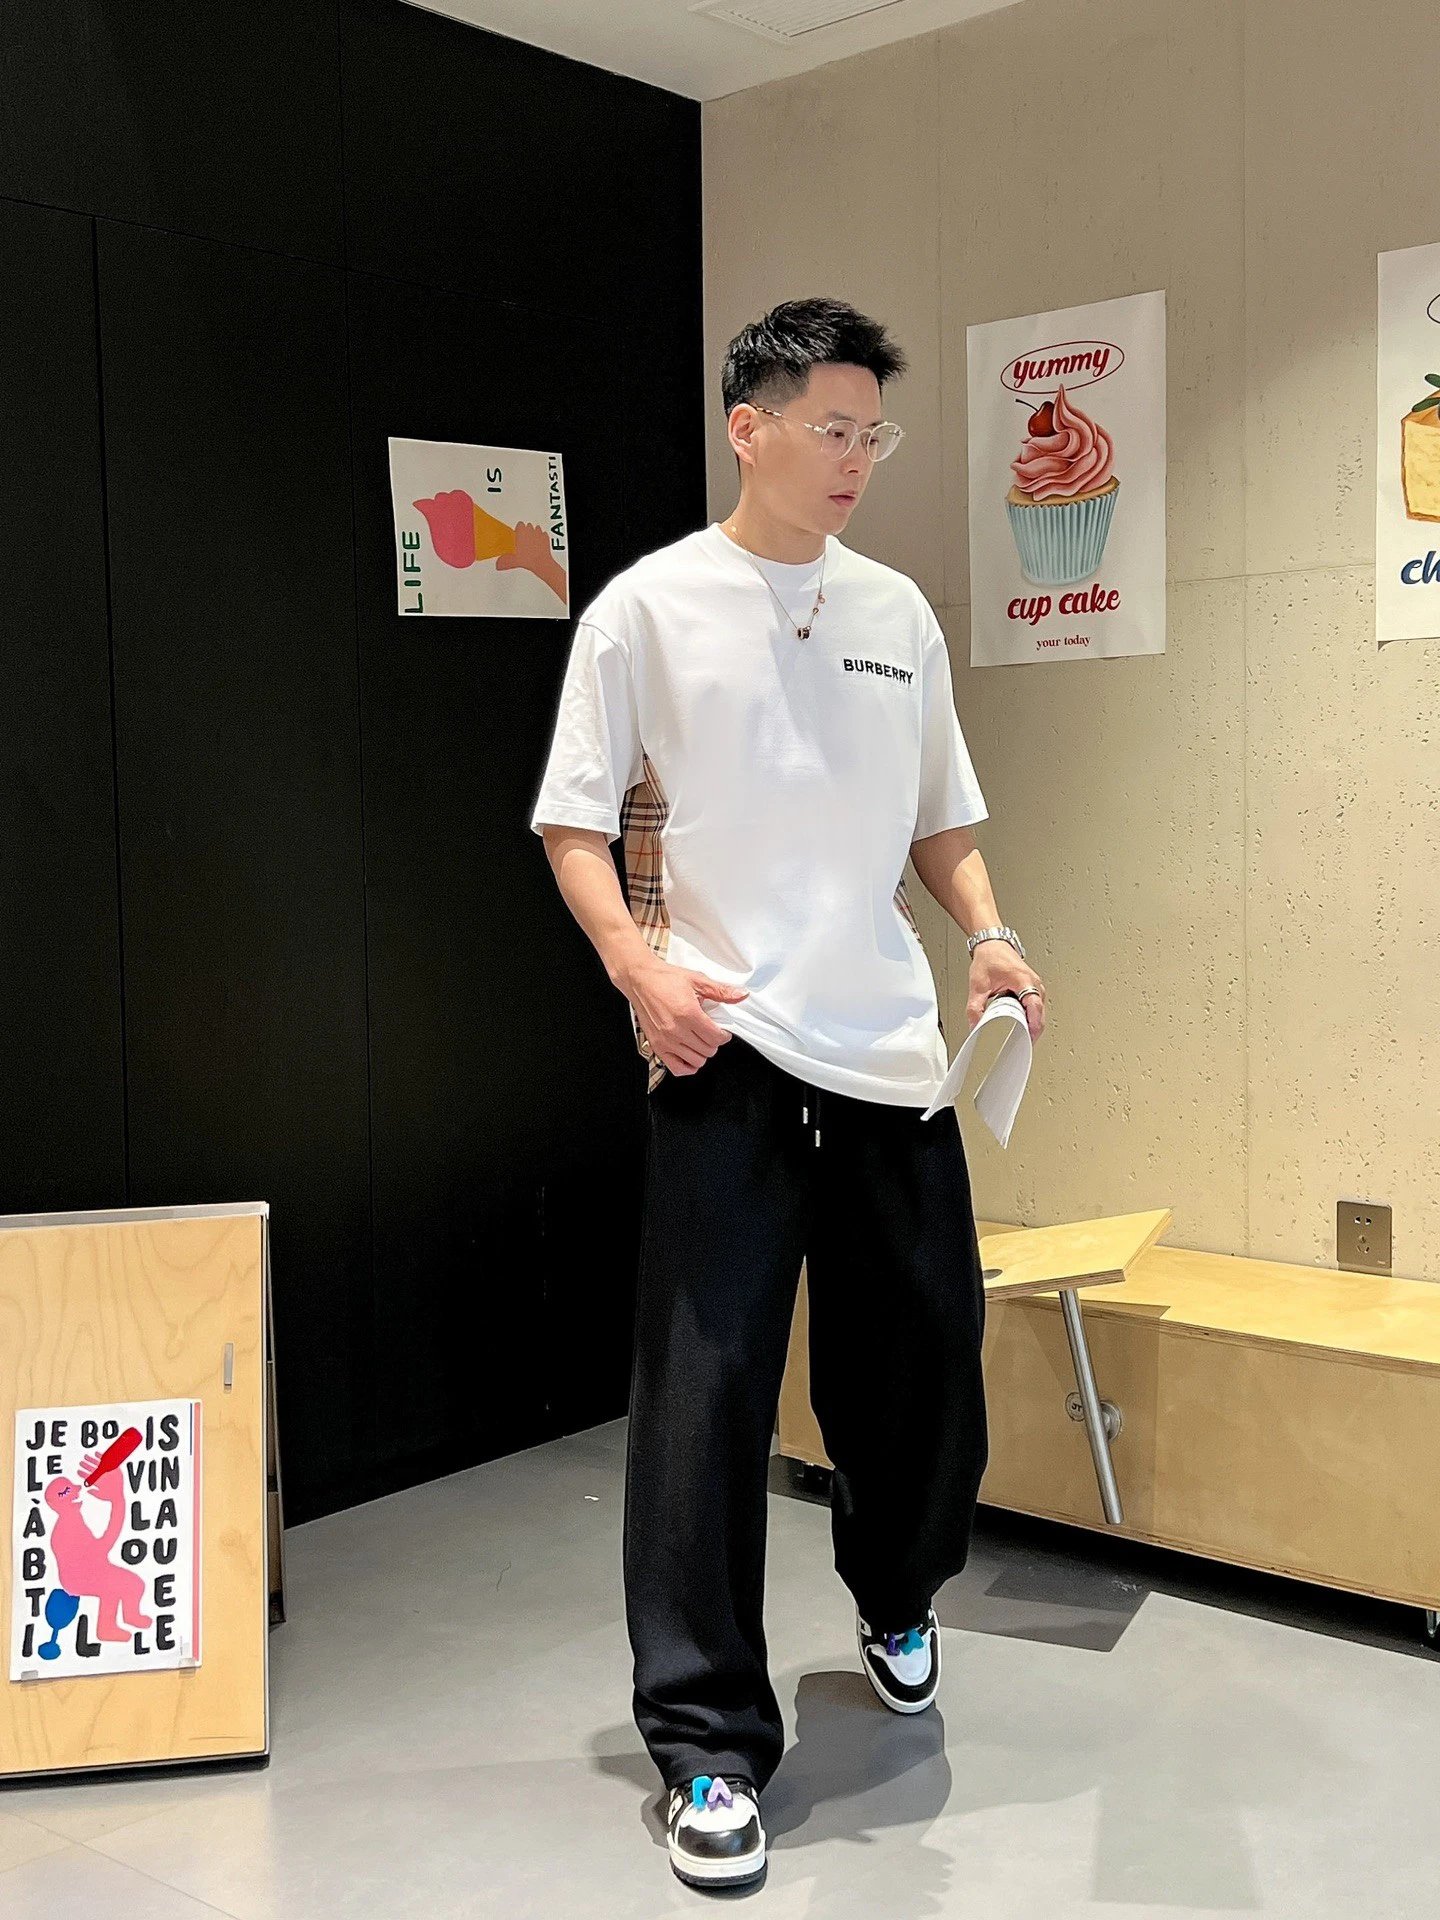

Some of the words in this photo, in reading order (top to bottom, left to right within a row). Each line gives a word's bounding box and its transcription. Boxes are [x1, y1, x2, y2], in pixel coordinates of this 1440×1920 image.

[1012, 347, 1110, 389] yummy
[486, 467, 502, 493] IS
[548, 456, 566, 551] FANTASTI
[402, 530, 424, 614] LIFE
[1007, 595, 1052, 626] cup
[1058, 583, 1121, 615] cake
[1036, 637, 1062, 651] your
[1064, 634, 1091, 647] today
[843, 658, 914, 685] BURBERRY
[25, 1420, 68, 1451] JE
[27, 1454, 63, 1493] LE
[126, 1455, 180, 1494] VIN
[23, 1498, 46, 1538] À
[130, 1498, 178, 1531] LA
